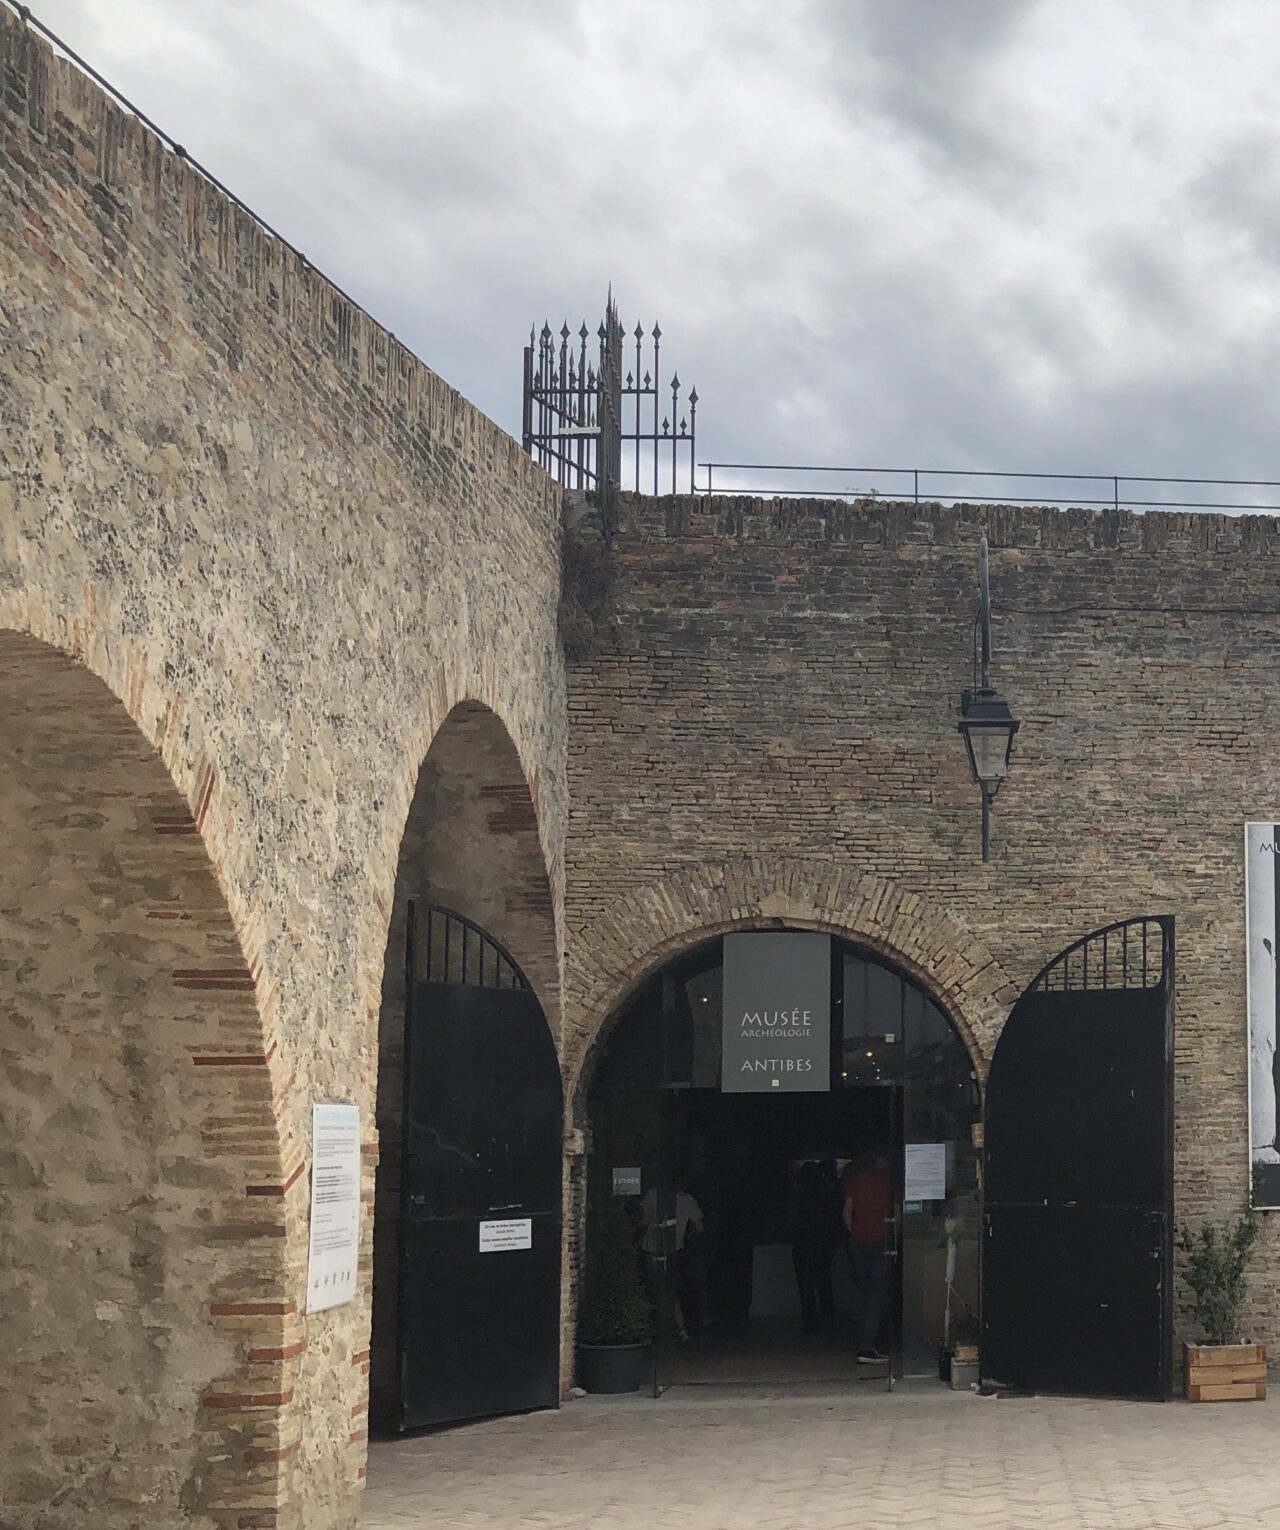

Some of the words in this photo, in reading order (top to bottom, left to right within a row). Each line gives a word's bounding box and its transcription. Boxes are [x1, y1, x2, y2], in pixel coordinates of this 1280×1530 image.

[741, 1007, 812, 1026] MUSÉE
[741, 1028, 812, 1037] ARCHÉOLOGIE
[741, 1059, 812, 1072] ANTIBES
